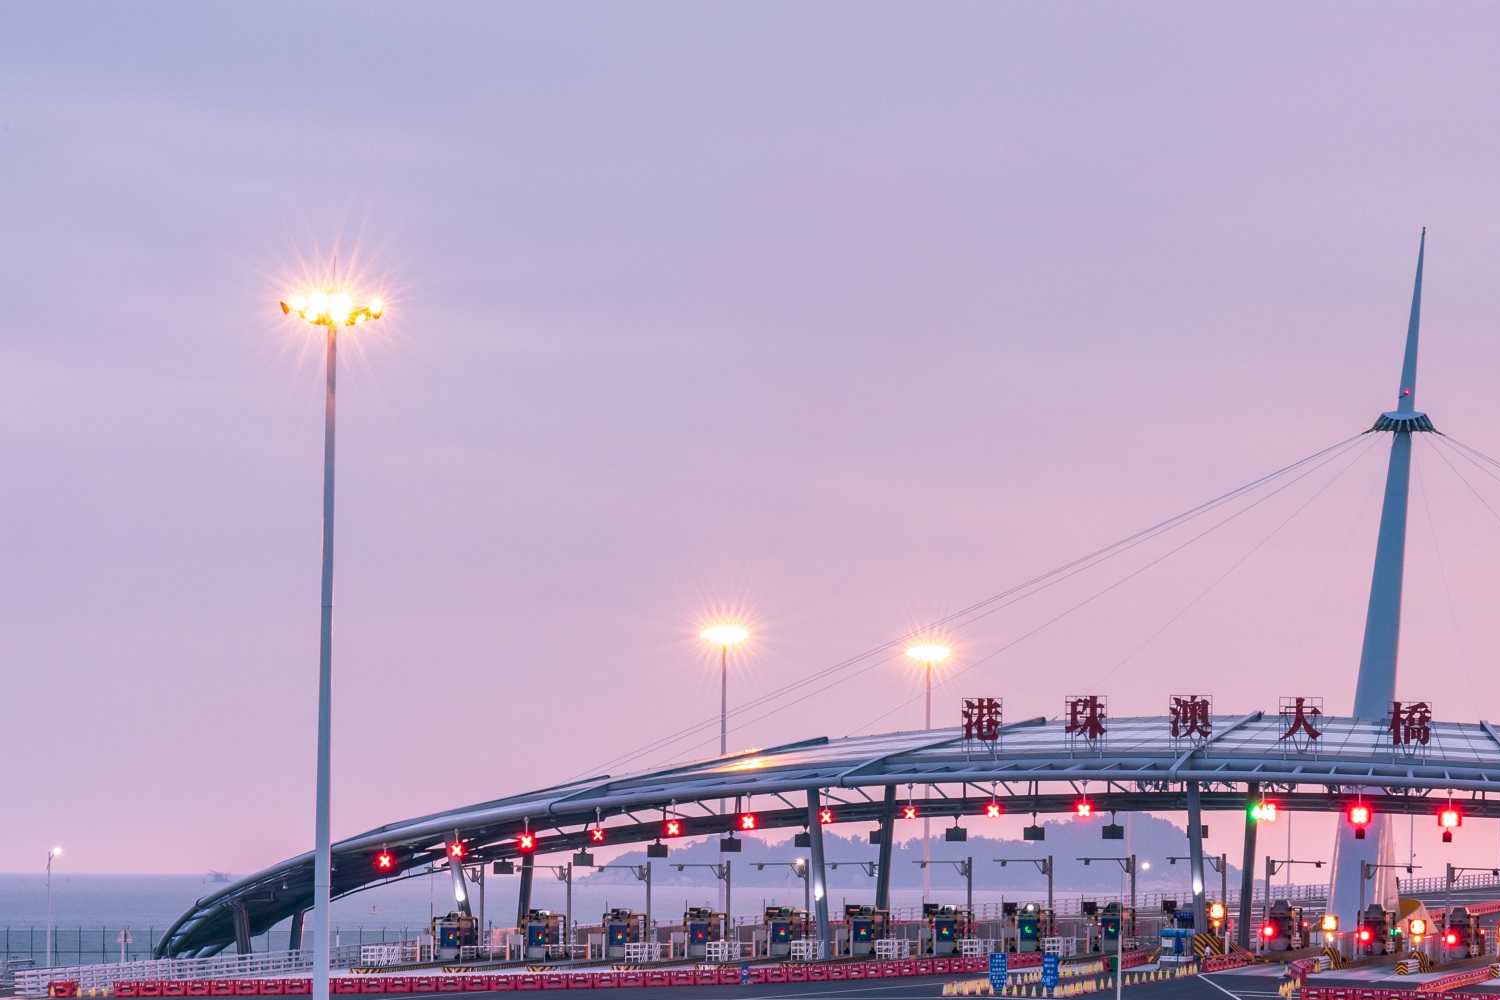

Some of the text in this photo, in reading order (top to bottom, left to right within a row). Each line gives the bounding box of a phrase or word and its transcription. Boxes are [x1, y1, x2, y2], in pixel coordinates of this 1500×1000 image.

[962, 695, 1431, 745] 港珠澳大橋
